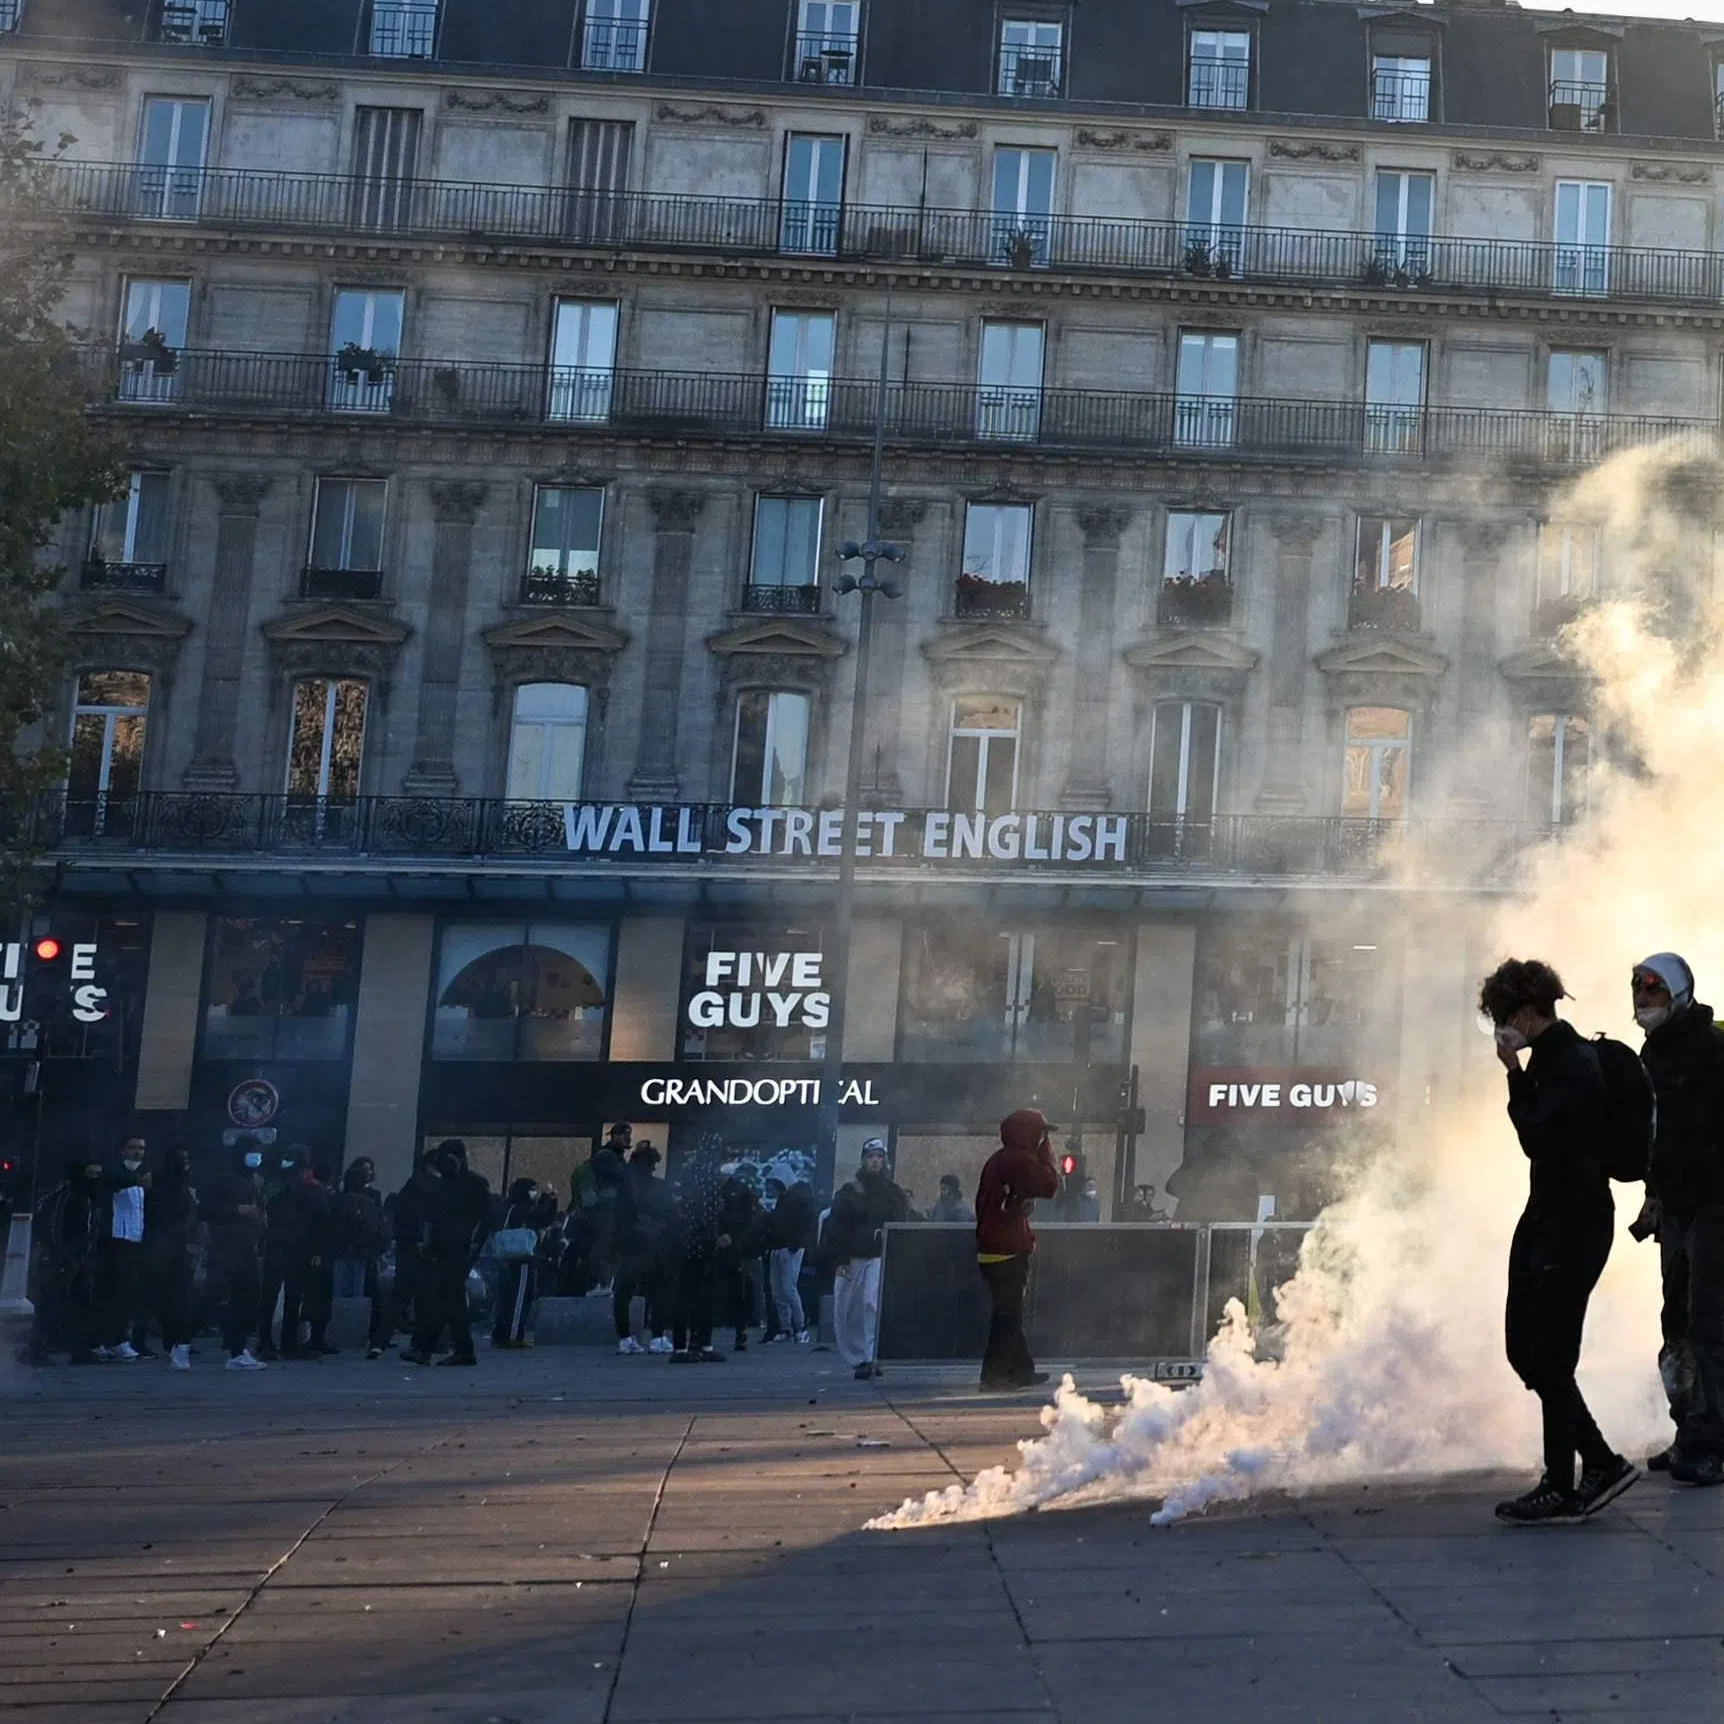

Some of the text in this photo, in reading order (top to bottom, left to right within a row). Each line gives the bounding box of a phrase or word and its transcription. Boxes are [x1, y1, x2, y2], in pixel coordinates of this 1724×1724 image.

[563, 803, 1127, 861] WALL STREET ENGLISH
[705, 951, 824, 988] FIVE
[688, 990, 831, 1028] GUYS
[640, 1078, 880, 1105] GRANDOPTIAL
[1208, 1083, 1281, 1108] FIVE
